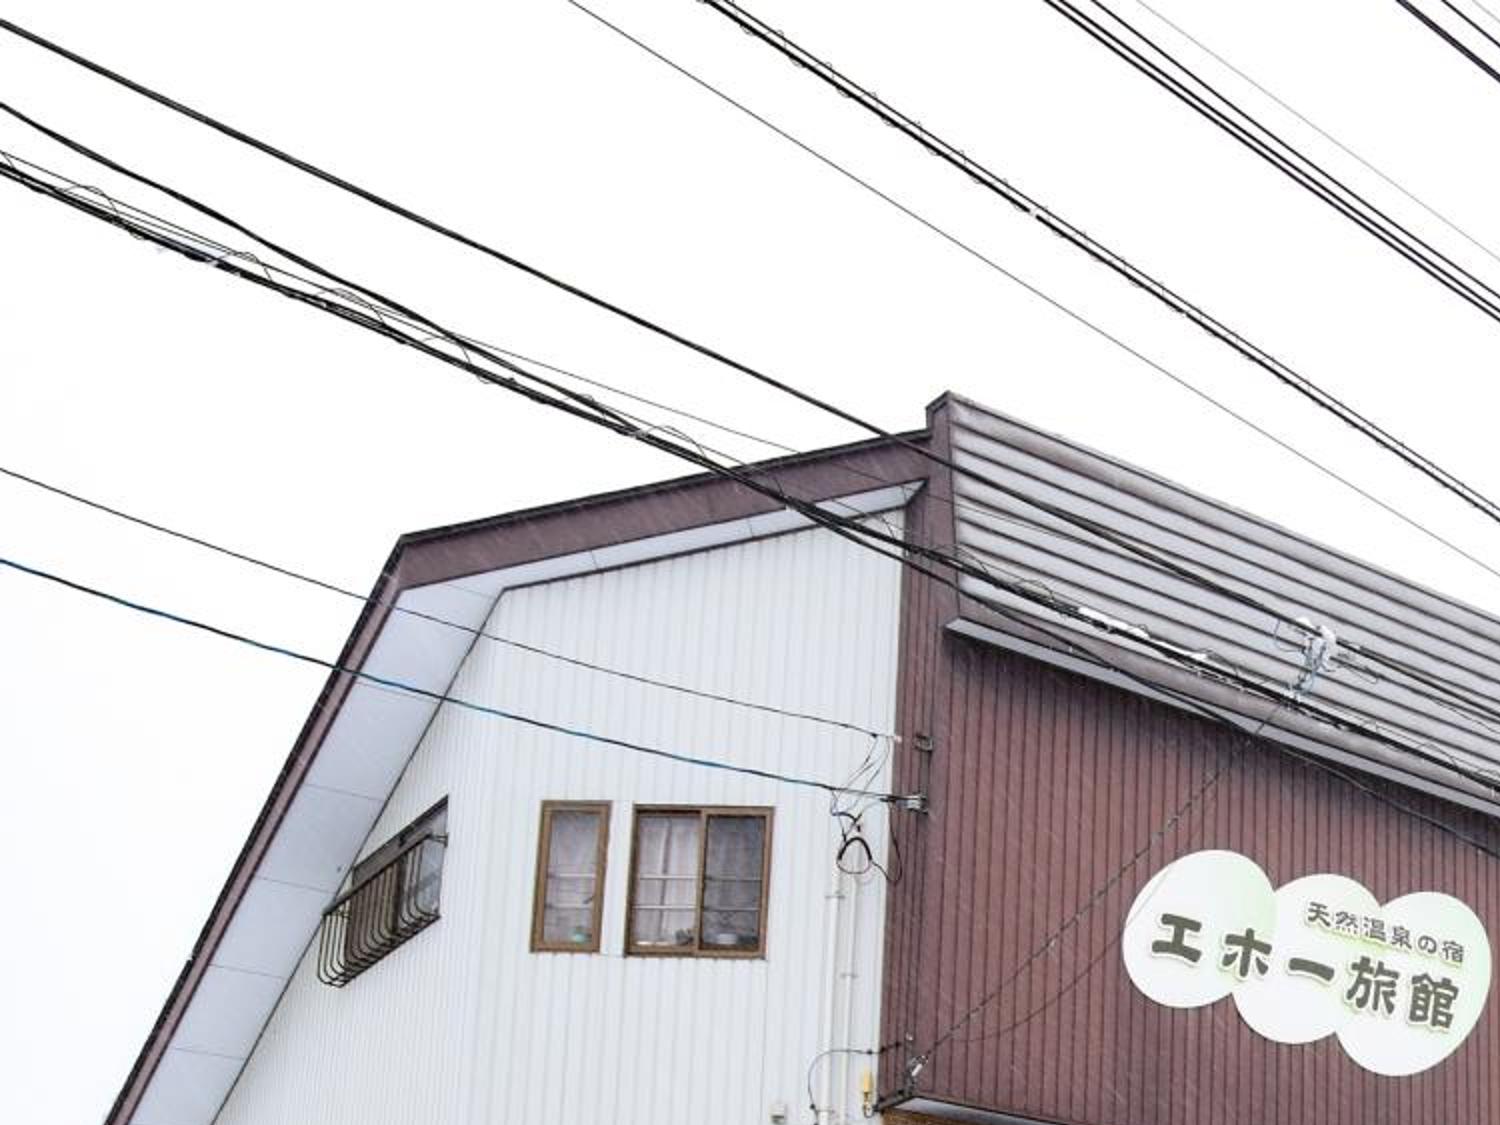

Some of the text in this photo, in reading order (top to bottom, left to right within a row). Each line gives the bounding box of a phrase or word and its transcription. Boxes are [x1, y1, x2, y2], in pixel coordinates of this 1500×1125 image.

[1307, 901, 1465, 964] 天然温泉の宿
